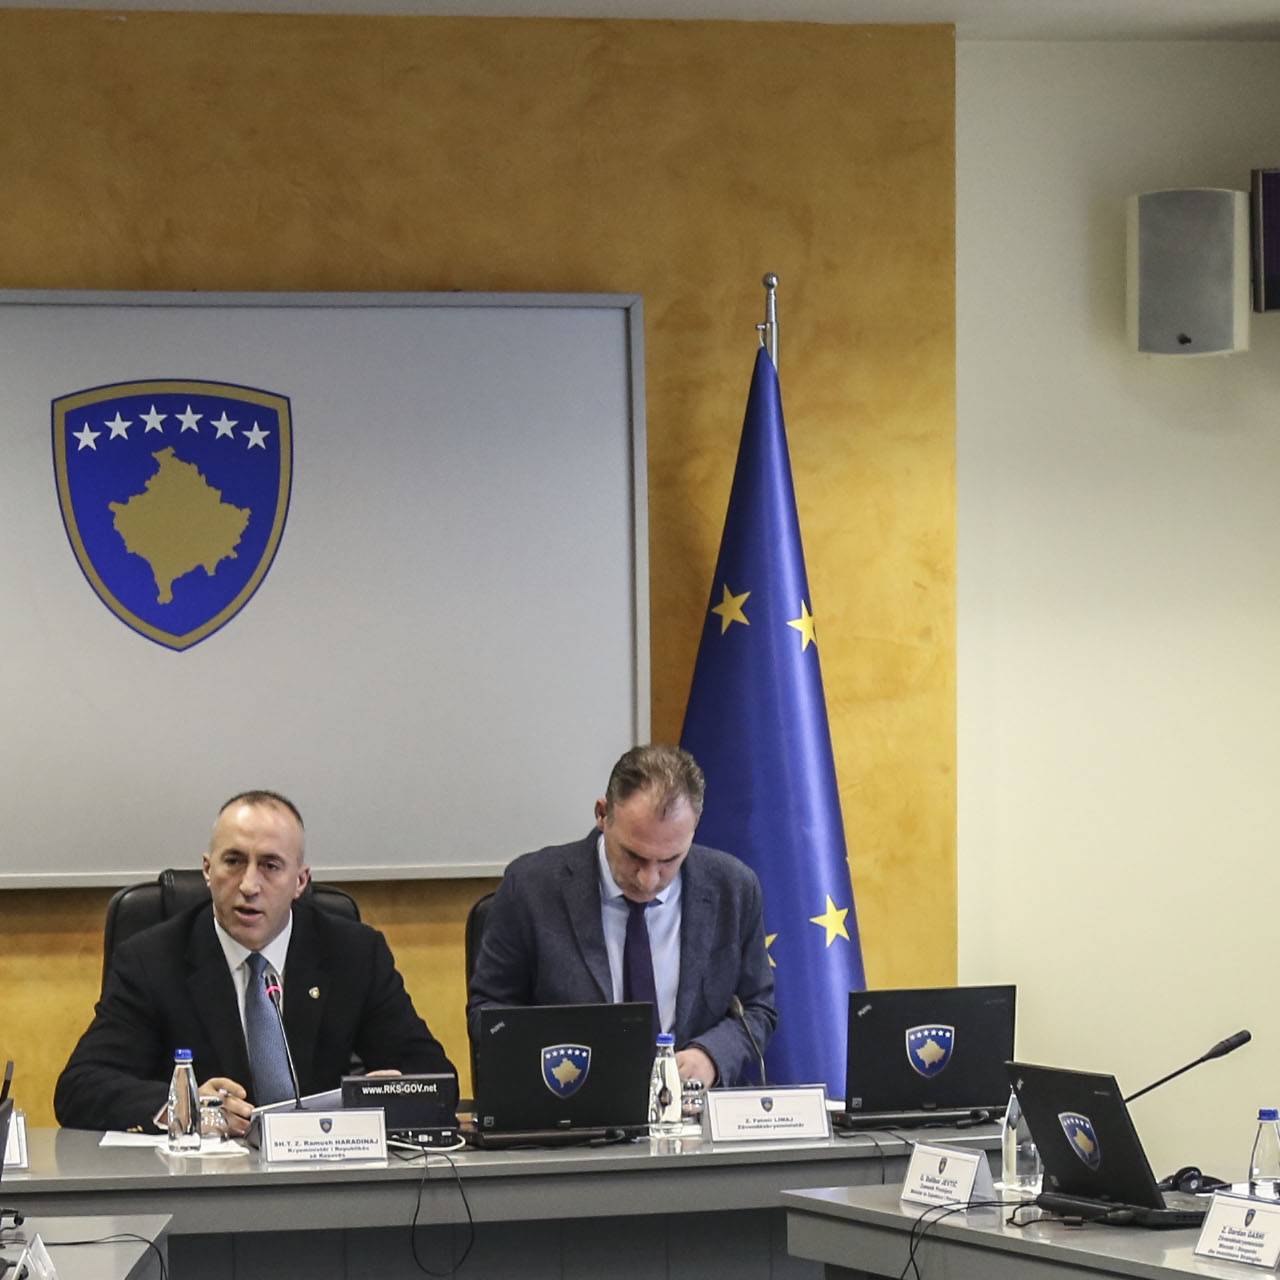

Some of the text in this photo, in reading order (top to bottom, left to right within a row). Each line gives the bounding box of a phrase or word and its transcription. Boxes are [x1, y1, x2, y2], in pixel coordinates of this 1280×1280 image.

[361, 1083, 438, 1095] www.RKS-GOV.net
[303, 1139, 334, 1147] Ramush
[335, 1138, 379, 1146] HARADINAJ
